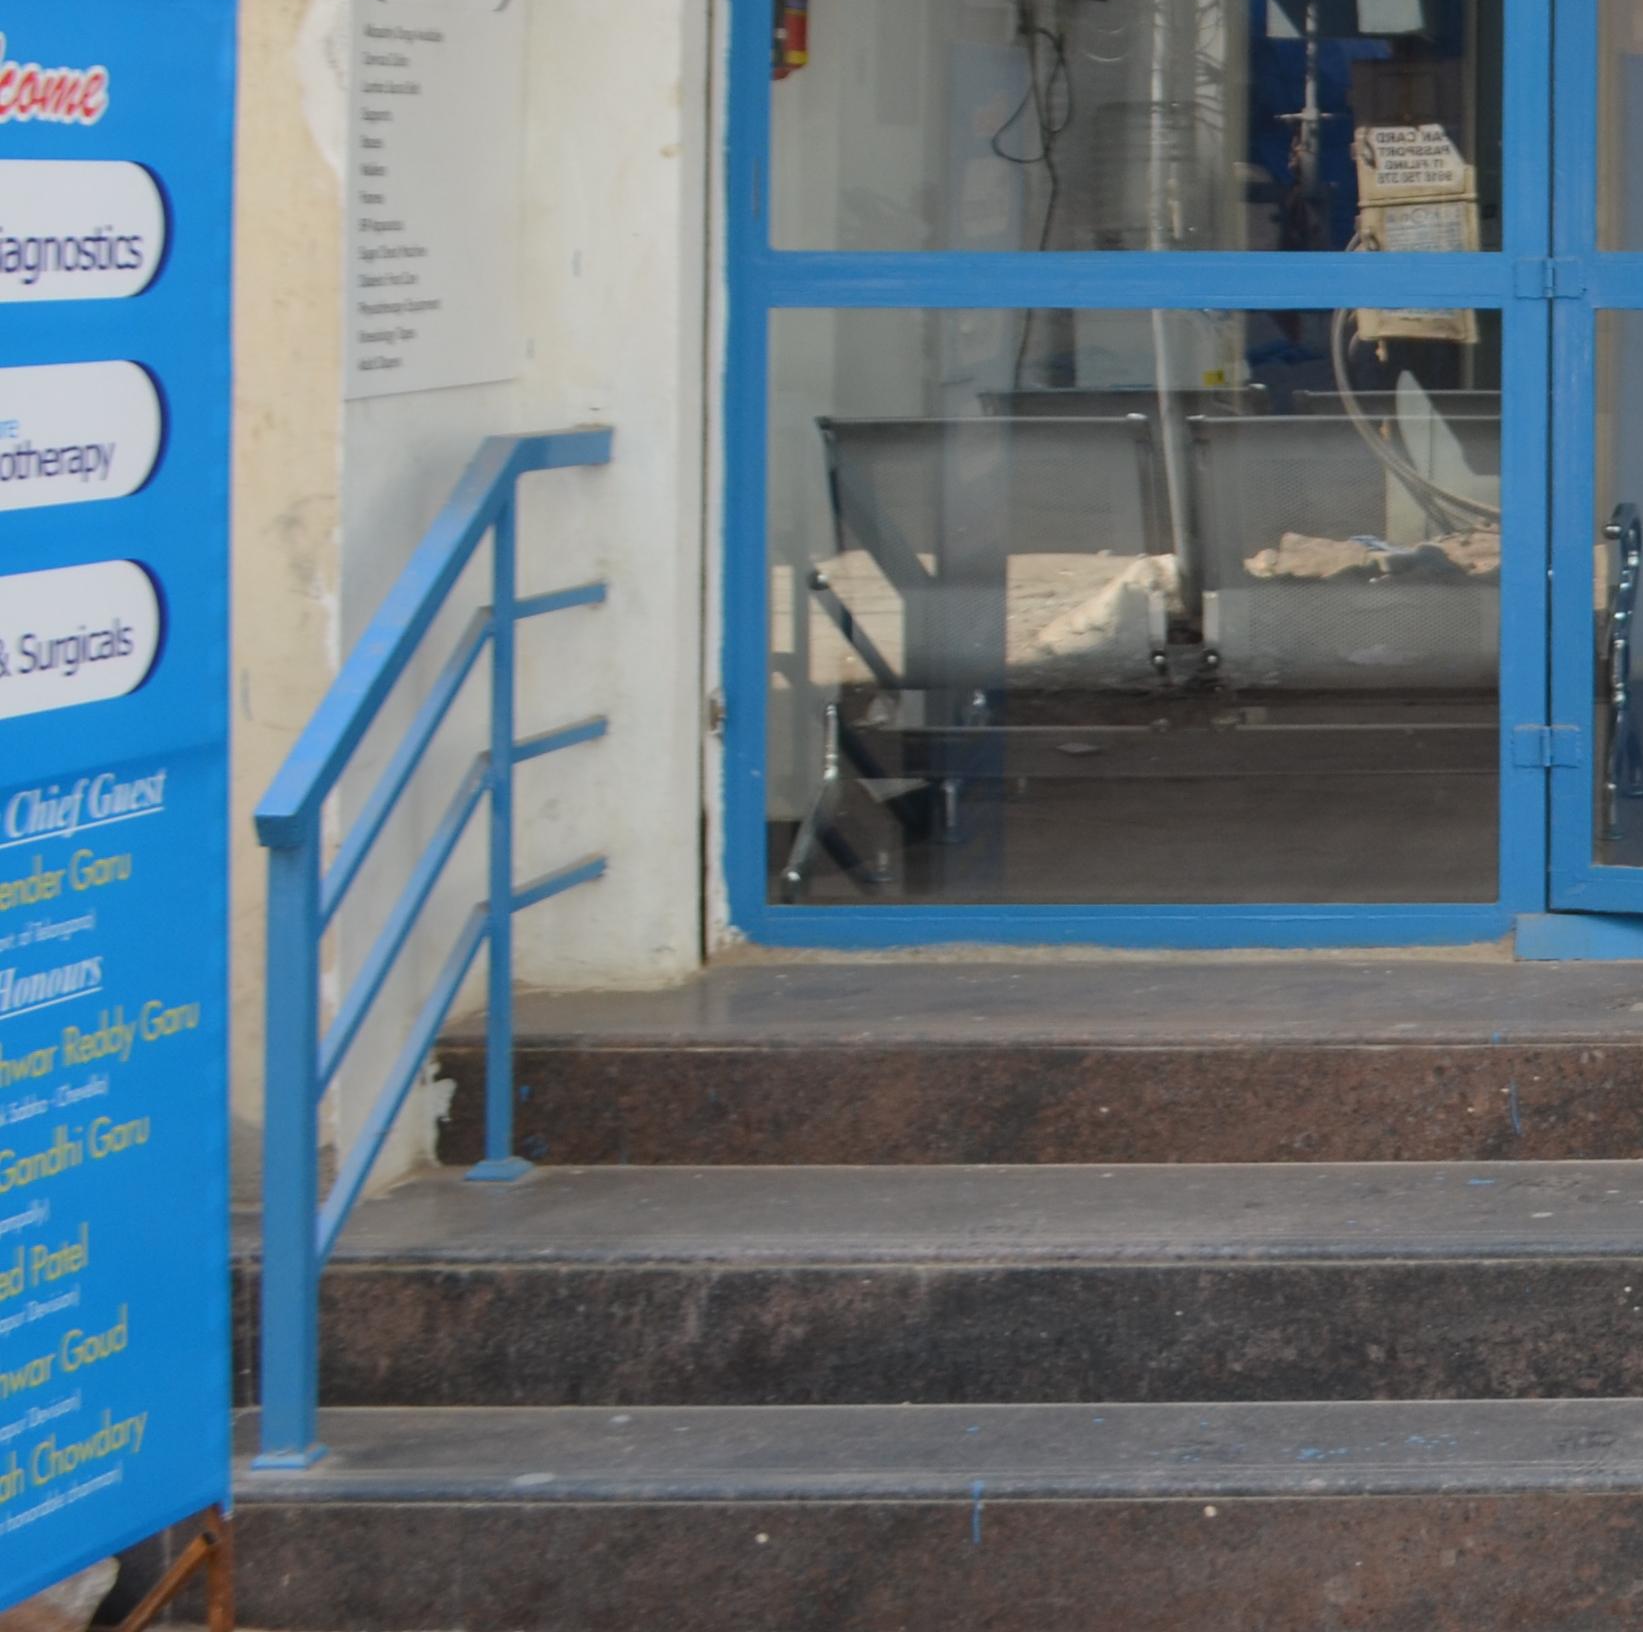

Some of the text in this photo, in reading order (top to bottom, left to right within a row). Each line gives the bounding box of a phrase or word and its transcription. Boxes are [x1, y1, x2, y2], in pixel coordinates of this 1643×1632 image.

[0, 32, 109, 126] come
[17, 616, 136, 678] Surgicals
[5, 767, 168, 839] Chief Guest
[69, 848, 133, 893] Garu
[63, 1004, 140, 1067] Reddy
[140, 999, 202, 1043] Garu
[88, 1115, 151, 1161] Garu
[31, 1221, 91, 1288] Patel
[61, 1302, 129, 1374] Goud
